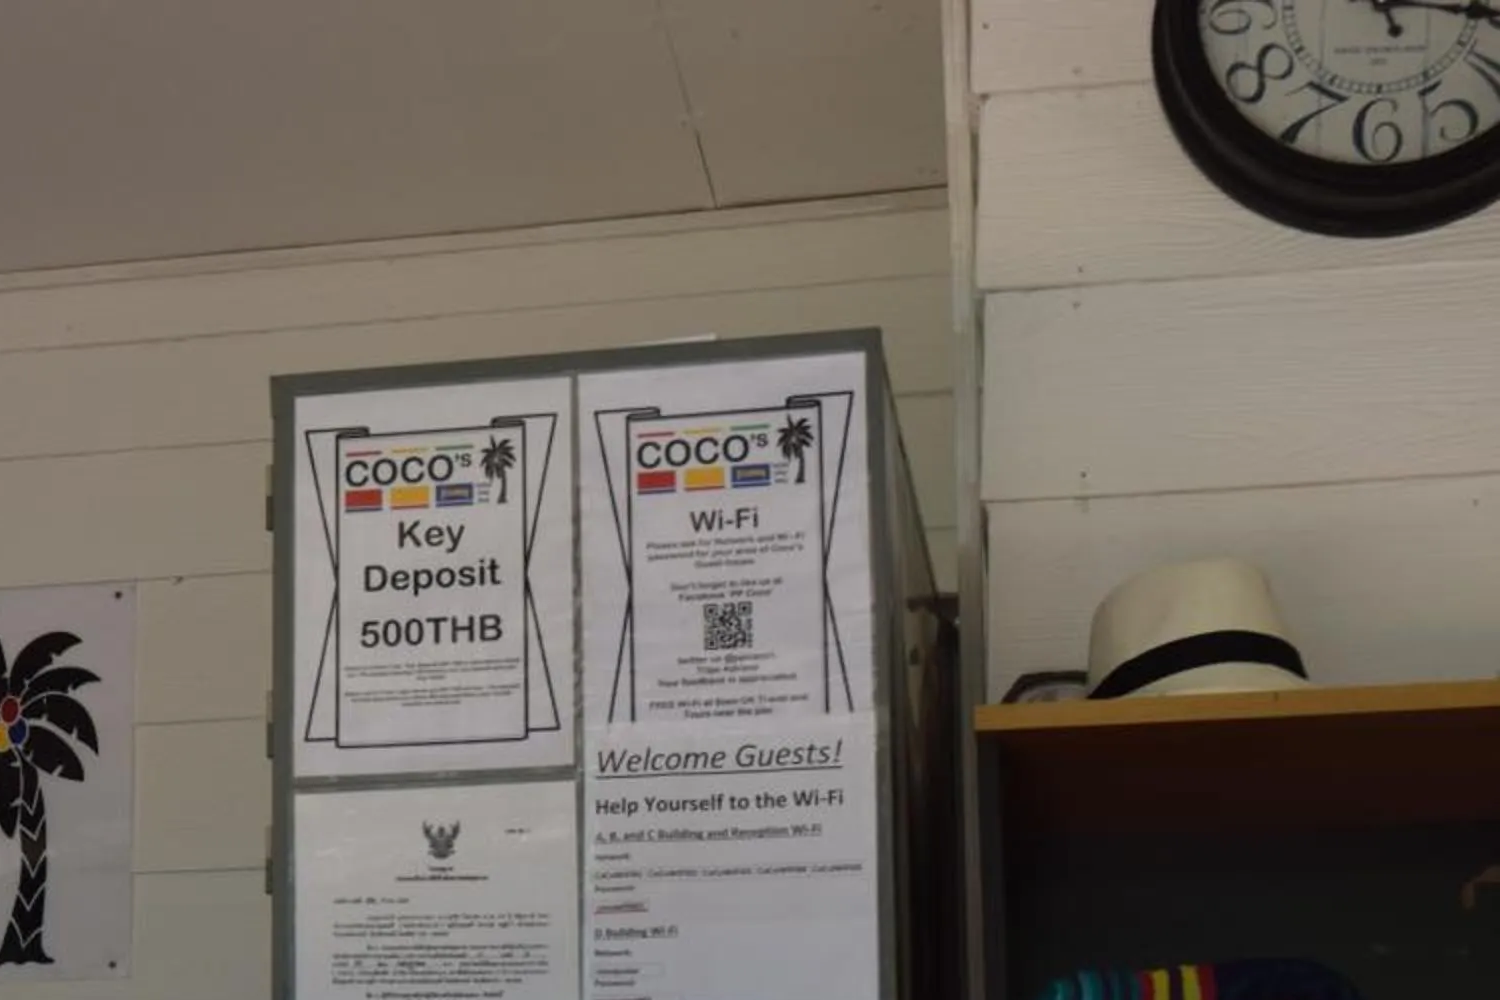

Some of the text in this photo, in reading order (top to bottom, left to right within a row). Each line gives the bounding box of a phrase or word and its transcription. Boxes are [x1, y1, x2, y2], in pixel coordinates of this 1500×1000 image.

[1226, 43, 1294, 104] 8
[1282, 80, 1350, 144] 7
[1417, 79, 1478, 142] 5
[1353, 98, 1403, 163] 6
[398, 520, 465, 553] Key
[689, 507, 759, 532] Wi-Fi
[364, 558, 501, 597] Deposit
[361, 614, 503, 649] 500THB
[596, 739, 844, 774] Welcome Guests!
[595, 788, 845, 818] Help Yourself to the Wi-Fi
